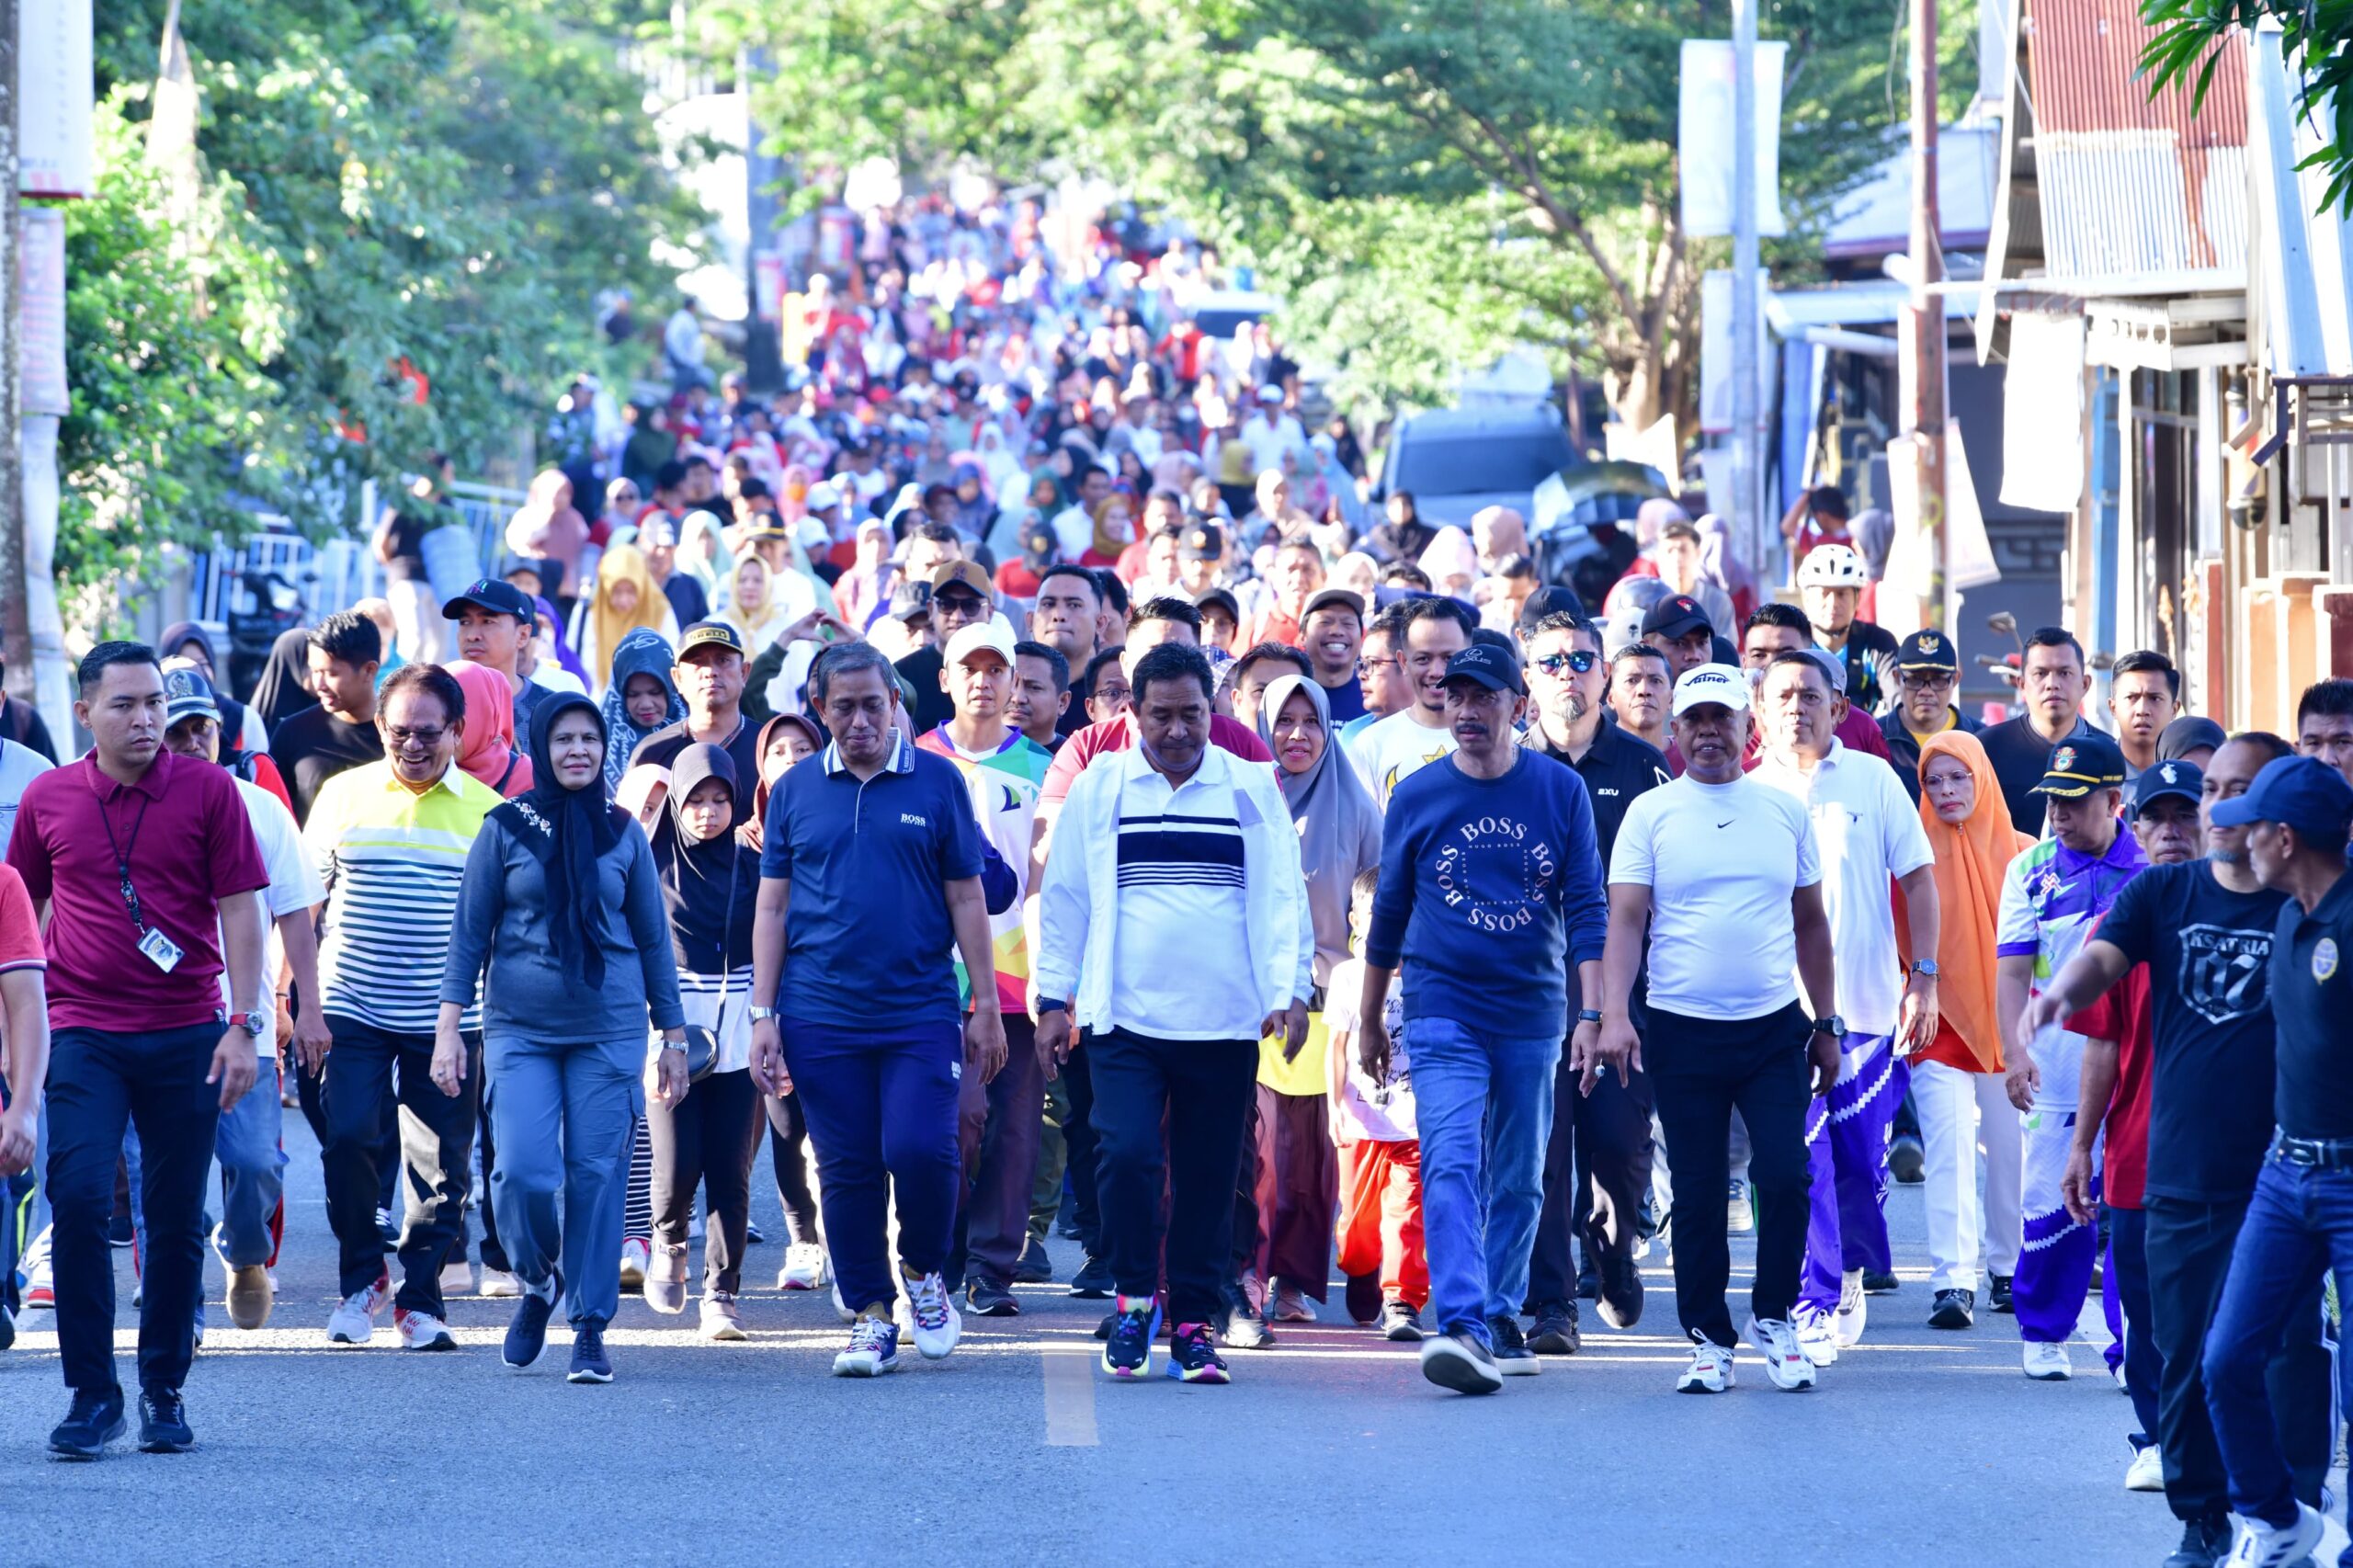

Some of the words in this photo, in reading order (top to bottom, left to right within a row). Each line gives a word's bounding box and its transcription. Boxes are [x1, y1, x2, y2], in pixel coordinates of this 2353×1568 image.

[1454, 656, 1492, 665] LEXUS
[1597, 788, 1620, 796] 2XU
[901, 812, 926, 824] BOSS
[1460, 816, 1528, 842] BOSS
[1436, 844, 1464, 907] BOSS
[1530, 842, 1554, 904] BOSS
[1467, 906, 1533, 931] BOSS
[2189, 931, 2269, 956] KSATRIA
